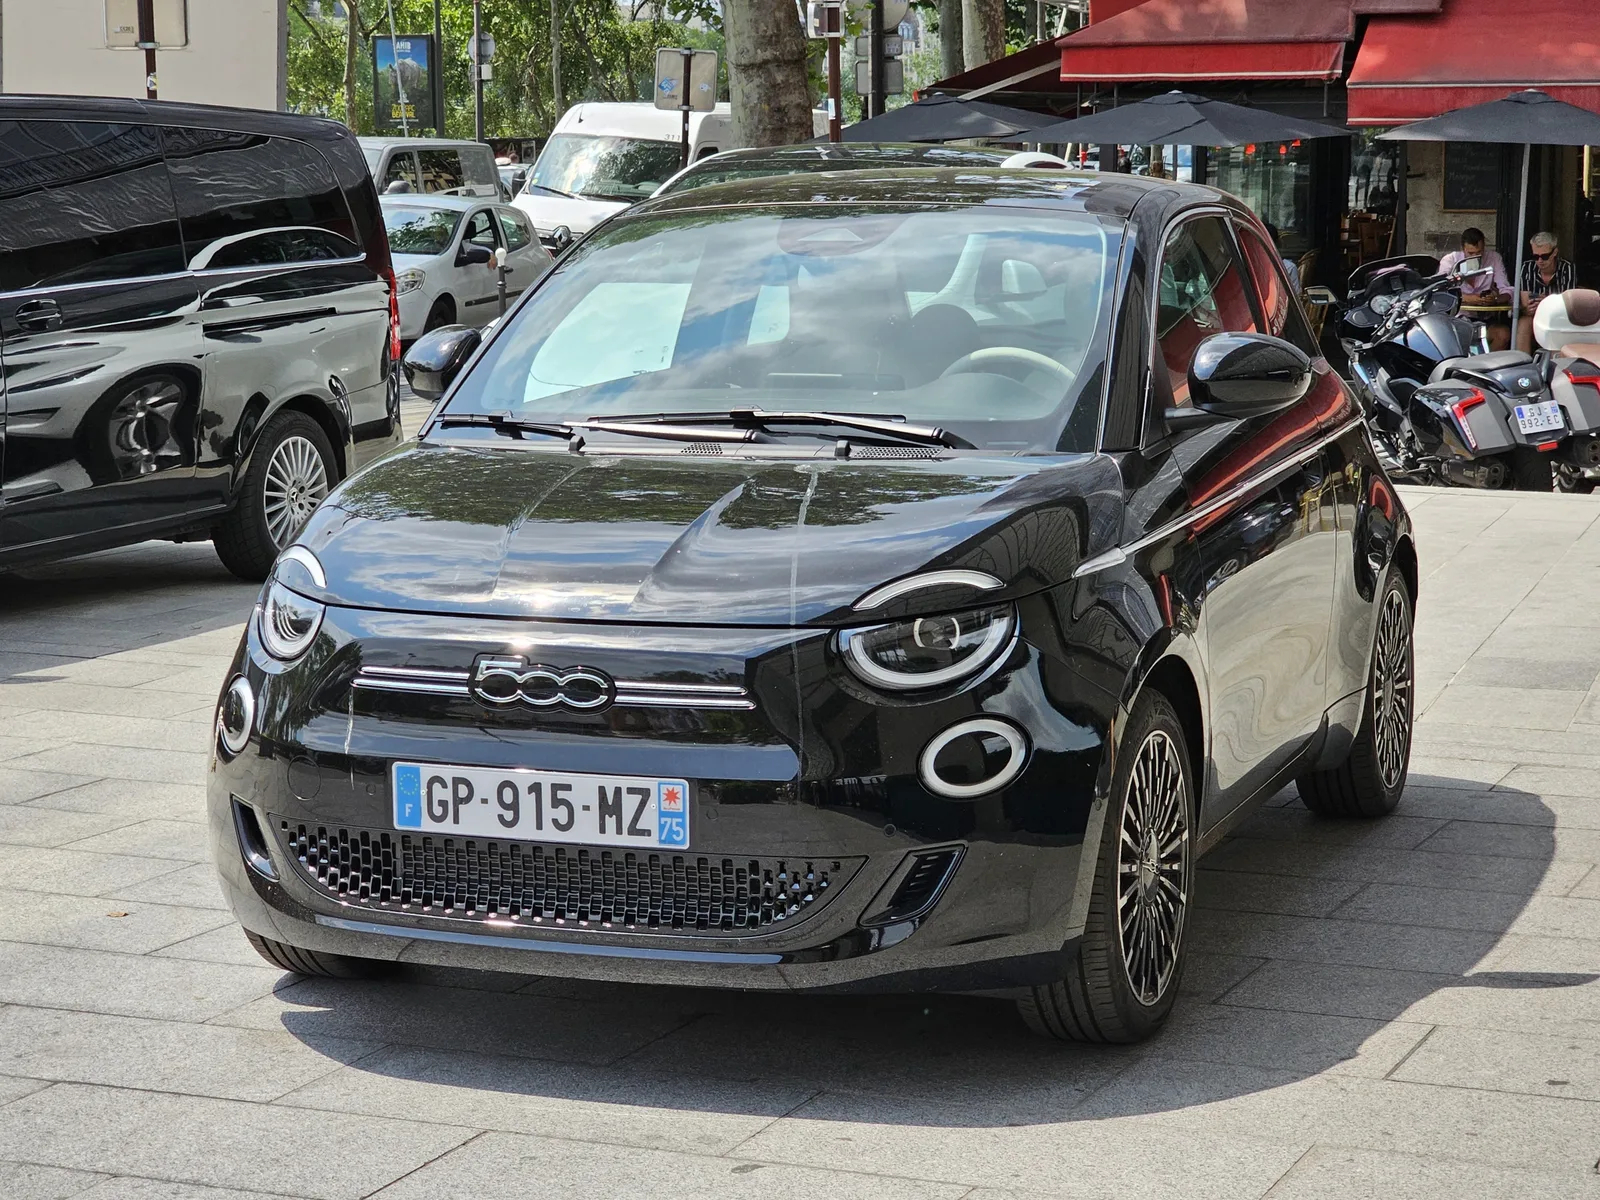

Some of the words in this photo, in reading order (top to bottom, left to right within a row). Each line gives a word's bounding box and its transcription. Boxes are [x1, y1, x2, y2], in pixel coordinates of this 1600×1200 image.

[474, 660, 609, 708] 500
[405, 803, 413, 818] F
[426, 775, 652, 838] GP-915-MZ
[660, 817, 684, 842] 75
